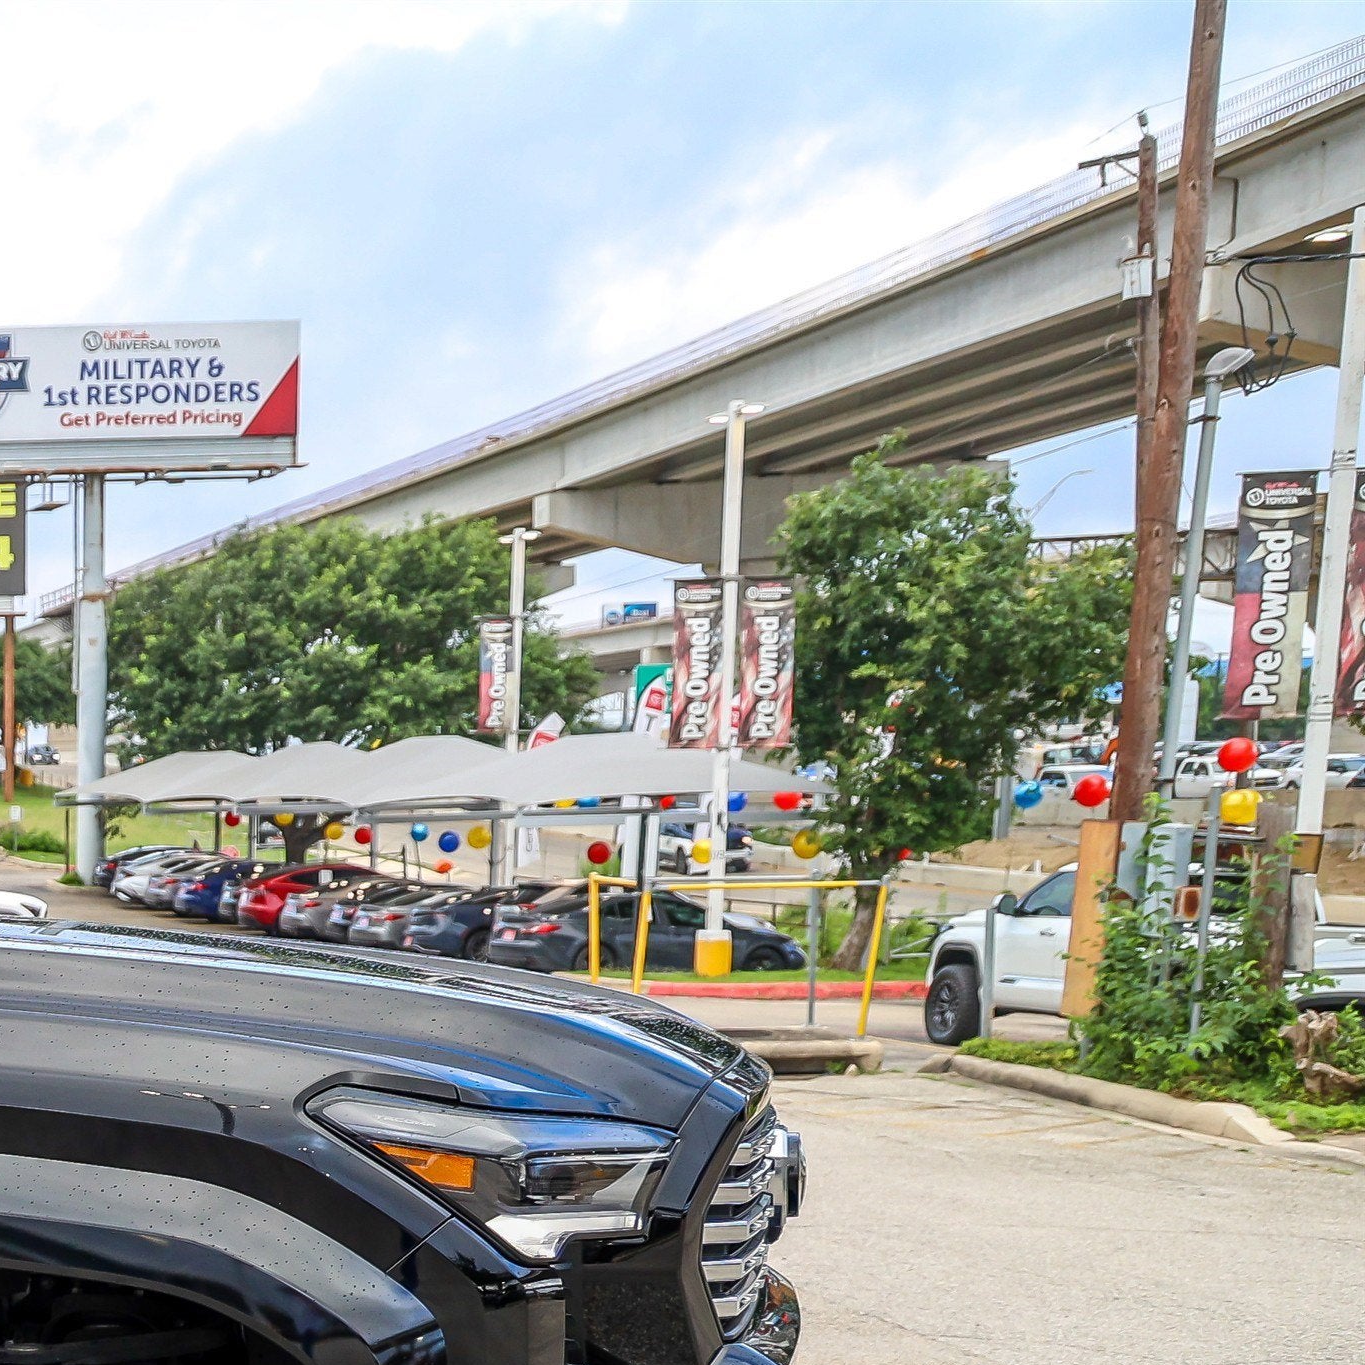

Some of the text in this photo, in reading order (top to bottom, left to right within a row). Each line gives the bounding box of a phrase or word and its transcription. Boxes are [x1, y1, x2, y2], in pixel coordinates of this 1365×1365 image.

[103, 338, 221, 350] UNIVERSAL TOYOTA
[79, 355, 226, 381] MILITARY &
[43, 380, 261, 407] 1st RESPONDERS
[59, 408, 243, 428] Get Preferred Pricing
[1250, 529, 1295, 645] Owned
[684, 617, 712, 698] Owned
[752, 615, 781, 697] Owned
[1241, 650, 1283, 706] Pre
[680, 700, 708, 741] Pre
[748, 700, 777, 740] Pre
